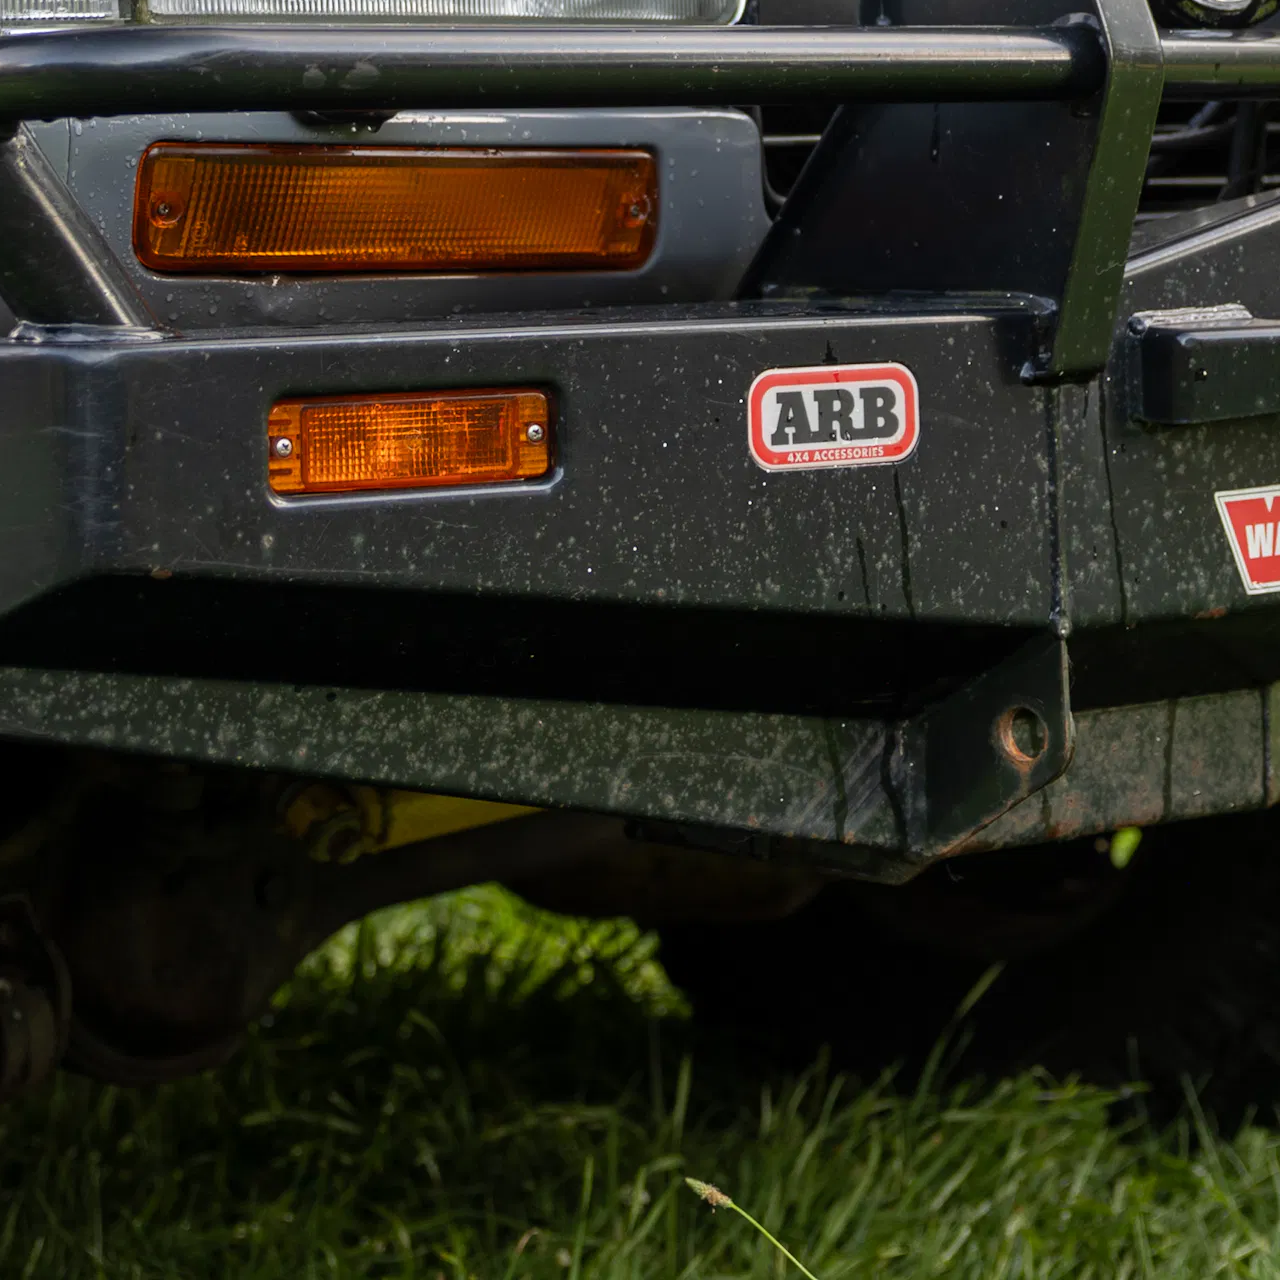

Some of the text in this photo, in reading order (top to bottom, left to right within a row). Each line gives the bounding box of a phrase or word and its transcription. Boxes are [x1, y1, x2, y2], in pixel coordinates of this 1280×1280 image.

[771, 386, 900, 446] ARB
[787, 446, 885, 464] 4X4 ACCESSORIES
